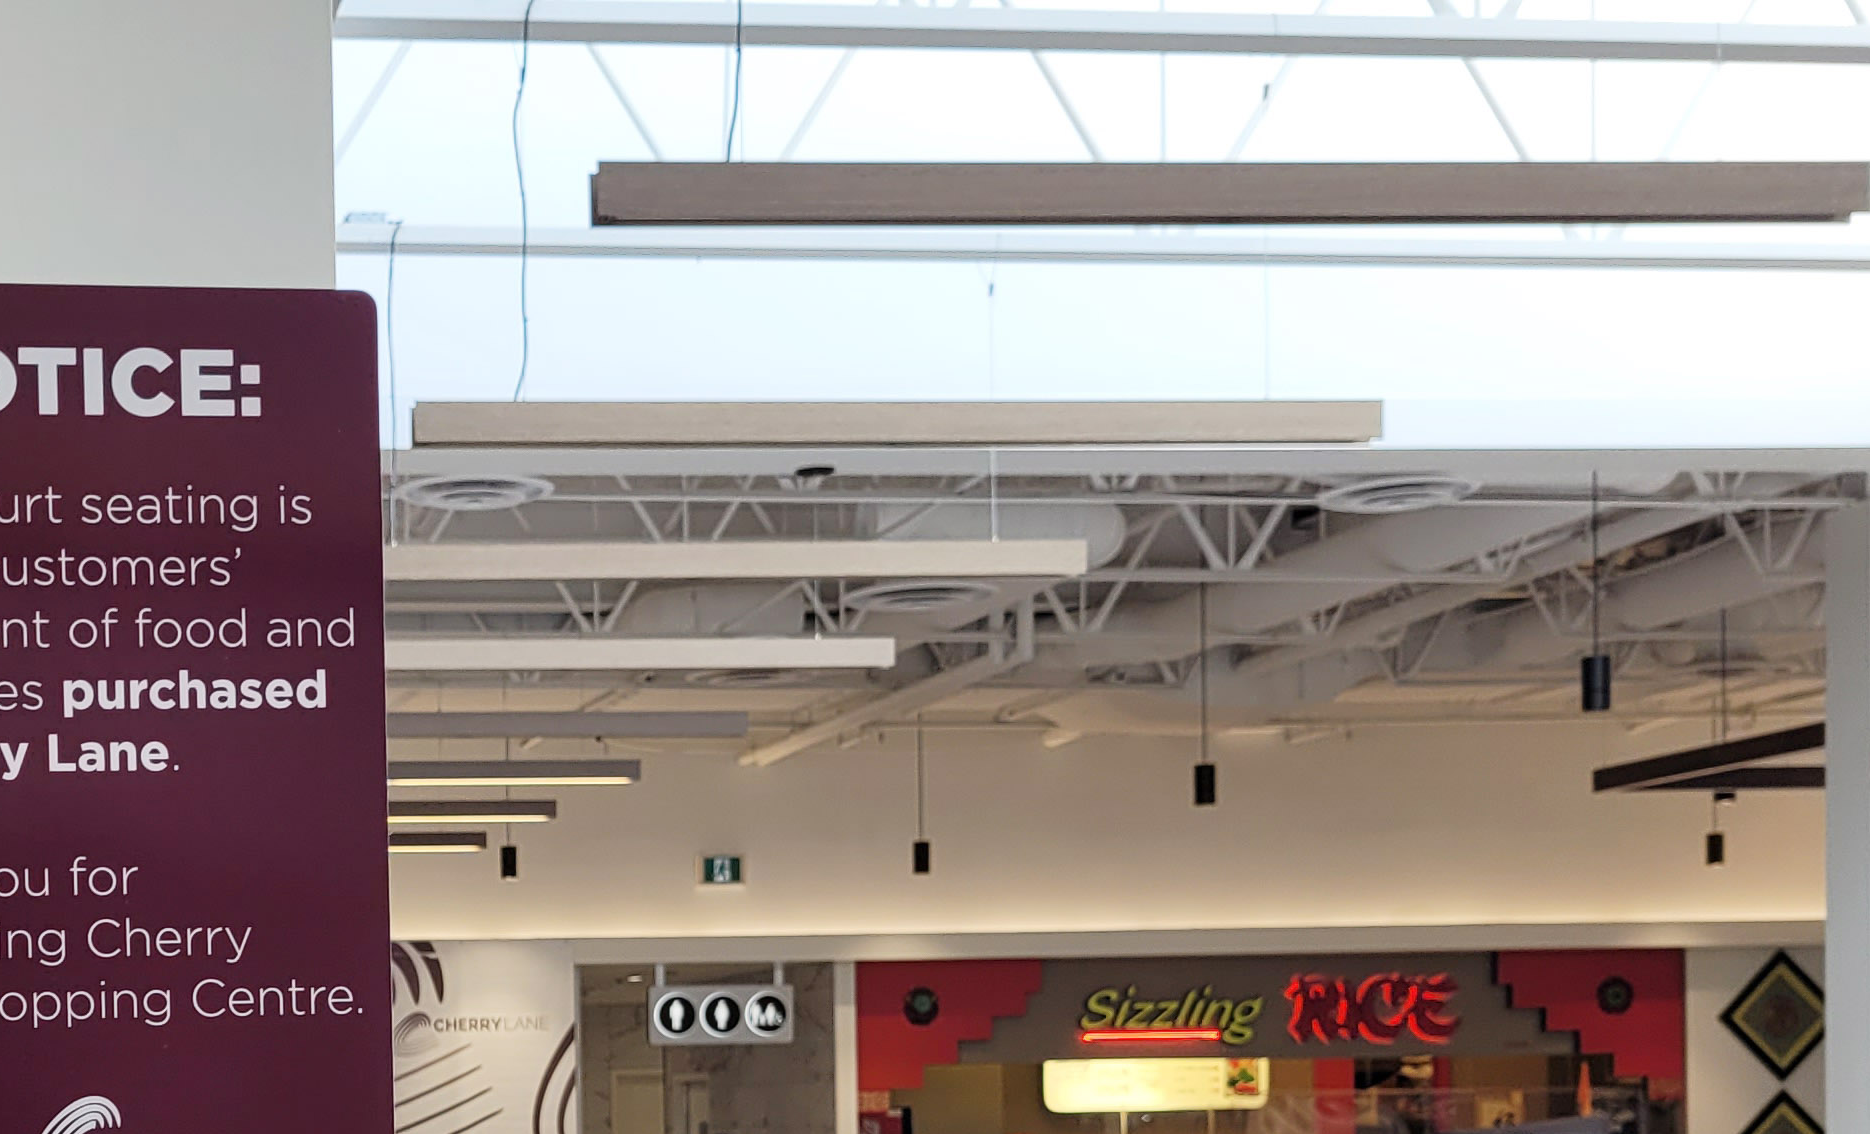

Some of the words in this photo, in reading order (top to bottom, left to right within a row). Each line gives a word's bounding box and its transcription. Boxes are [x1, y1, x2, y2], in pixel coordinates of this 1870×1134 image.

[81, 484, 258, 532] seating
[279, 485, 313, 525] is
[68, 607, 119, 649] of
[134, 607, 248, 649] food
[266, 607, 356, 648] and
[62, 668, 328, 718] purchased
[48, 733, 180, 774] Lane.
[69, 856, 139, 897] for
[87, 917, 252, 964] Cherry
[191, 978, 364, 1018] Centre.
[1080, 983, 1263, 1046] Sizzling
[1283, 971, 1463, 1046] RICE
